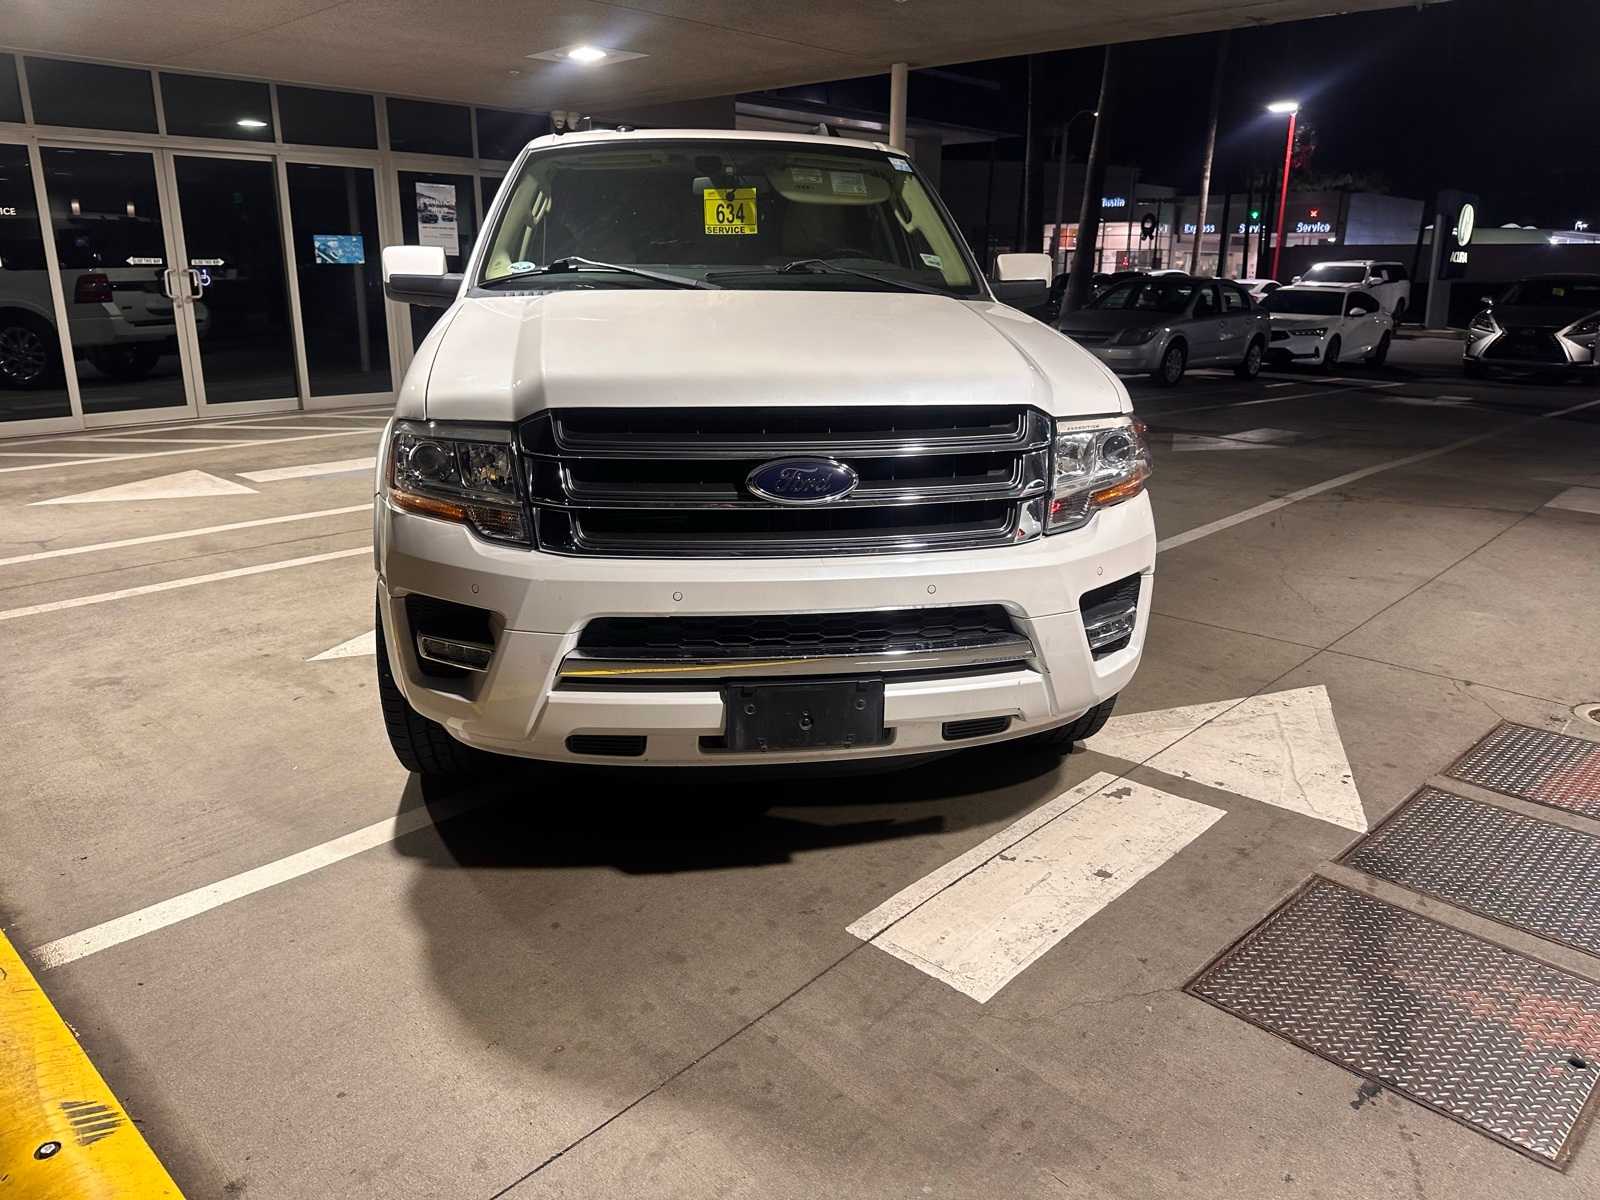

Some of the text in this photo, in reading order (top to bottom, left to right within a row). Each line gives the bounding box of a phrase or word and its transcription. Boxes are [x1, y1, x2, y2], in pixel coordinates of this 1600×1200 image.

[716, 203, 745, 224] 634
[706, 226, 746, 234] SERVICE
[1183, 224, 1216, 234] Expss
